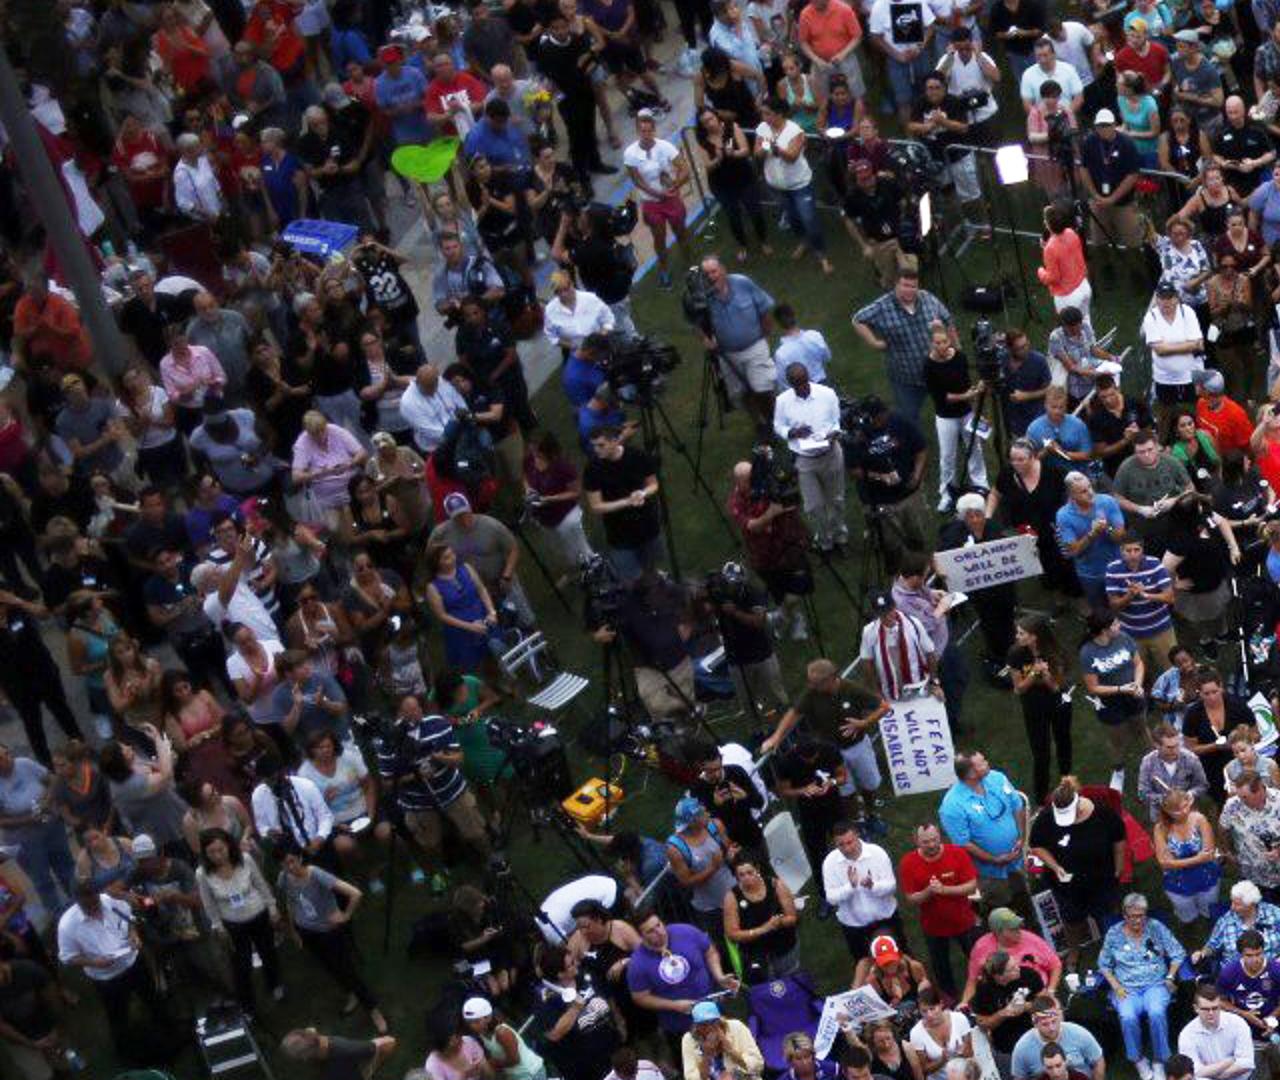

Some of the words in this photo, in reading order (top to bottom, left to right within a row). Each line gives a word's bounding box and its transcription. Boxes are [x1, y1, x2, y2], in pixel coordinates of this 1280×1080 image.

[954, 541, 1018, 564] ORLANDO
[963, 559, 994, 573] WILL
[1001, 554, 1017, 566] BE
[965, 565, 1026, 588] STRONG
[884, 707, 905, 772] DISABLE
[895, 771, 912, 790] US
[904, 710, 922, 746] WILL
[914, 748, 931, 778] NOT
[926, 718, 949, 767] FEAR
